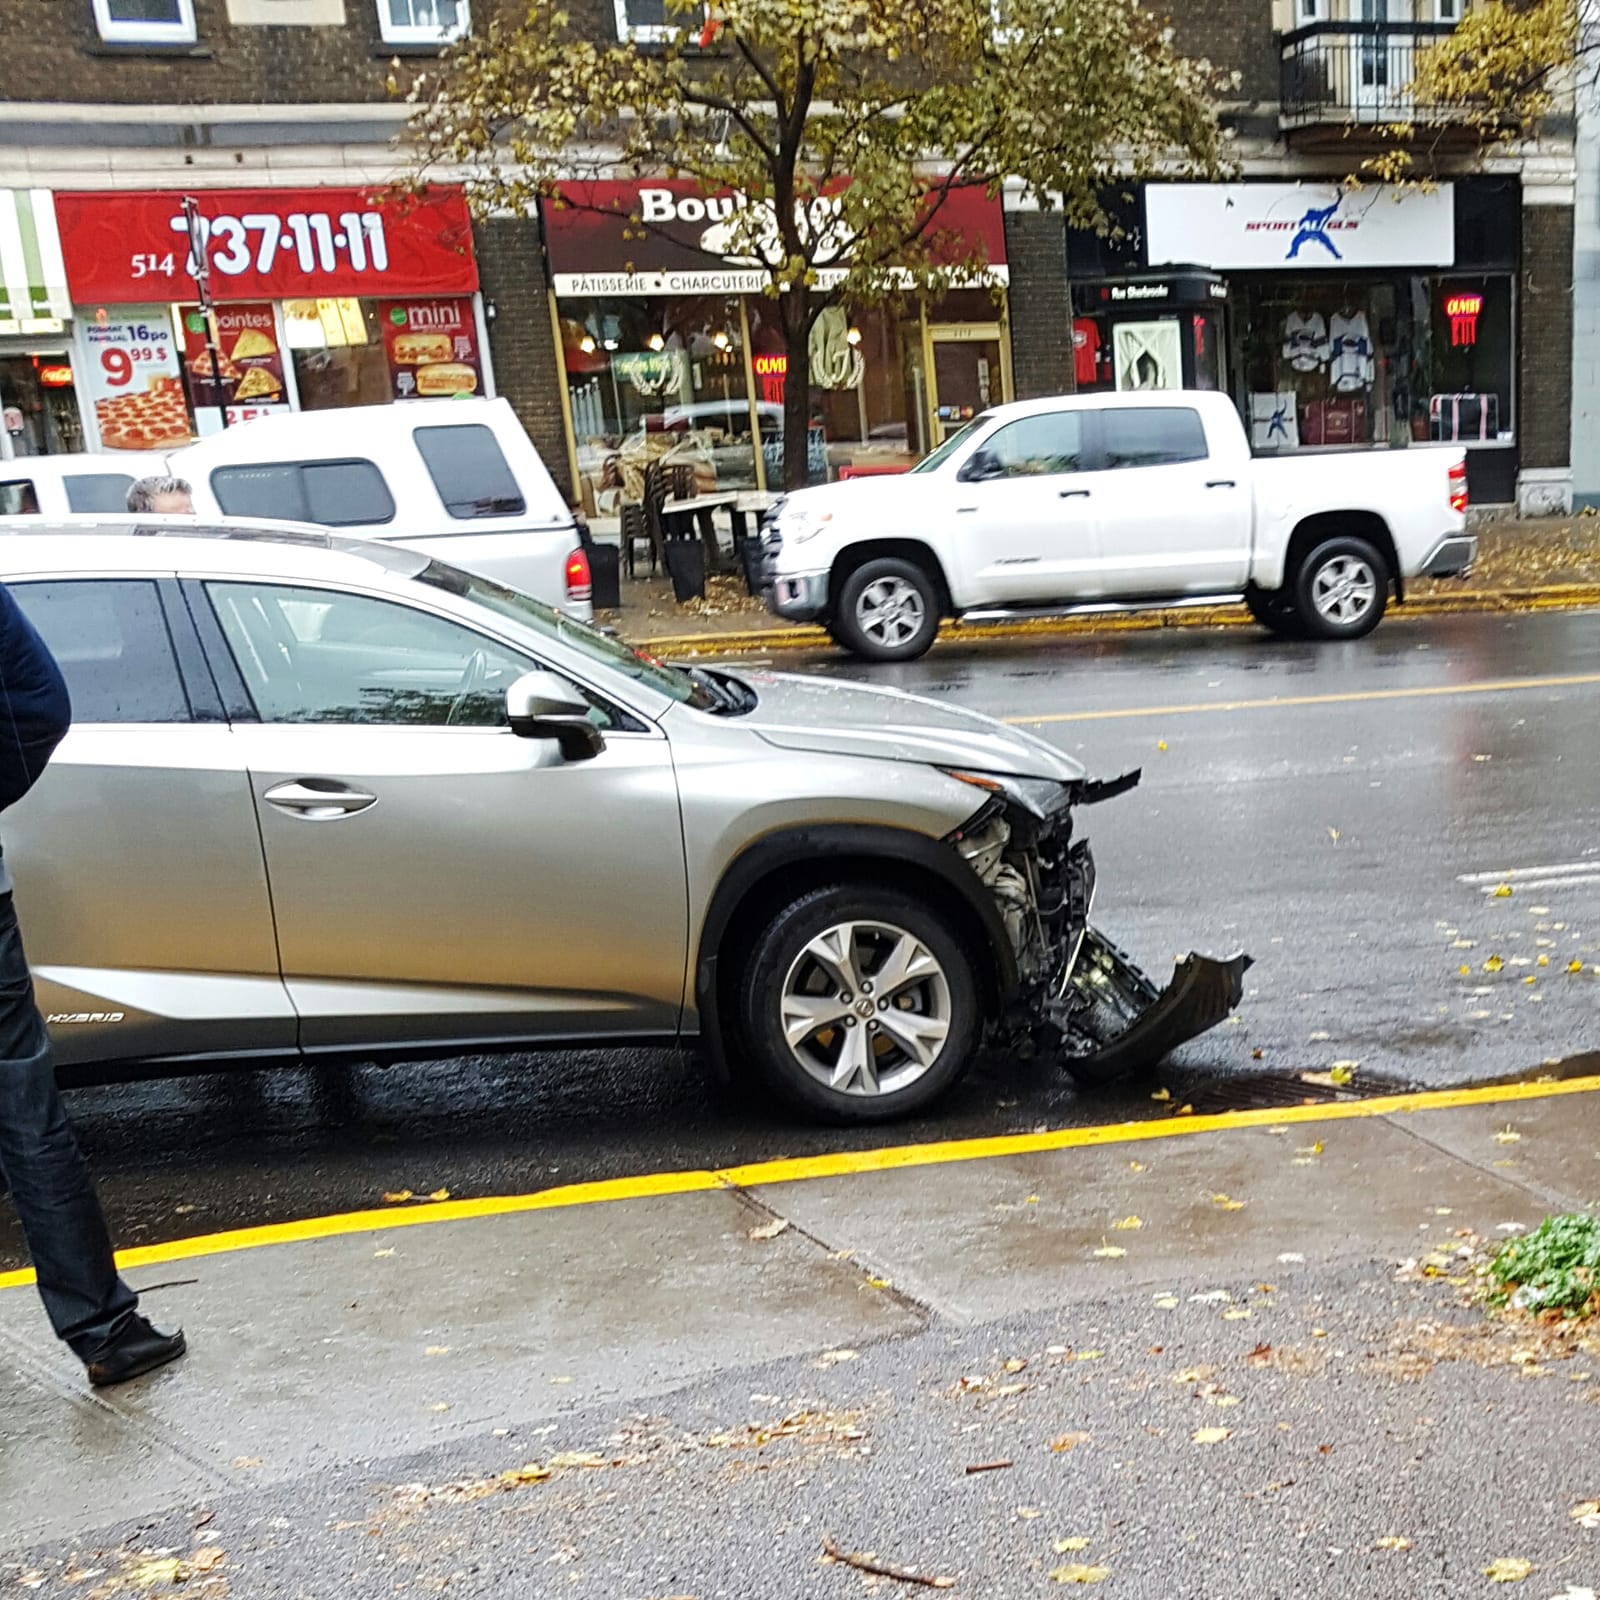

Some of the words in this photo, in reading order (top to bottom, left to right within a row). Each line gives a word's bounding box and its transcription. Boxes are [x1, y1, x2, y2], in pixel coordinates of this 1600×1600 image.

[131, 253, 175, 278] 514
[408, 301, 461, 325] mini
[45, 1011, 125, 1024] HYBRID
